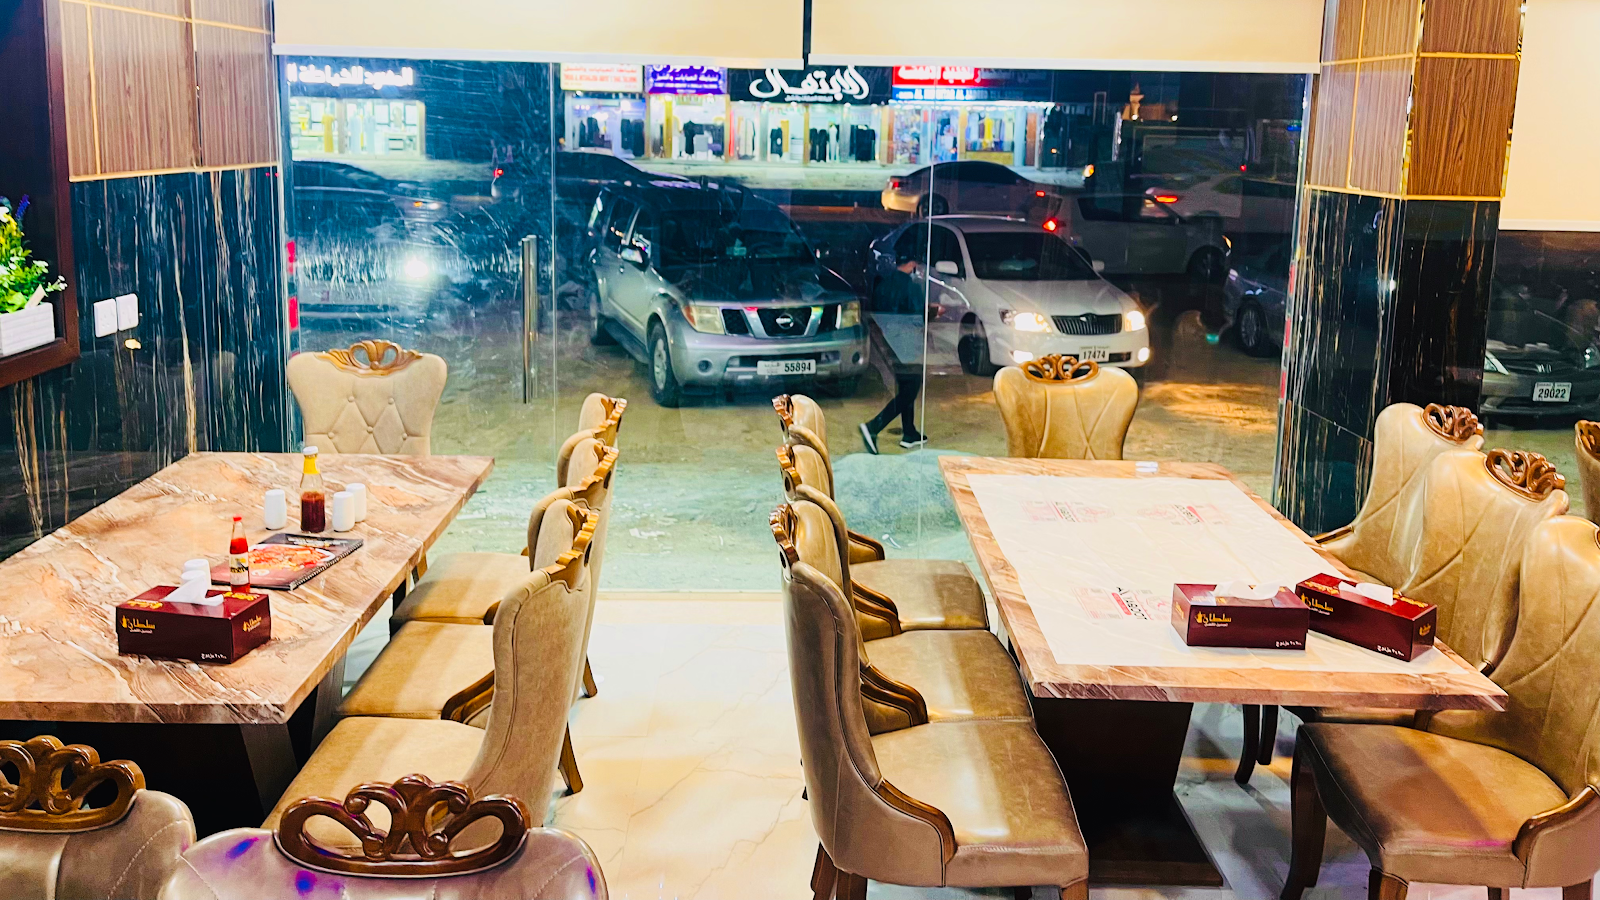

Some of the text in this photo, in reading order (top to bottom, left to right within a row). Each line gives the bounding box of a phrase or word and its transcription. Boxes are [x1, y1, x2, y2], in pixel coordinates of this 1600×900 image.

[1083, 350, 1106, 360] 17474
[784, 361, 811, 373] 55894
[1537, 388, 1566, 399] 29022
